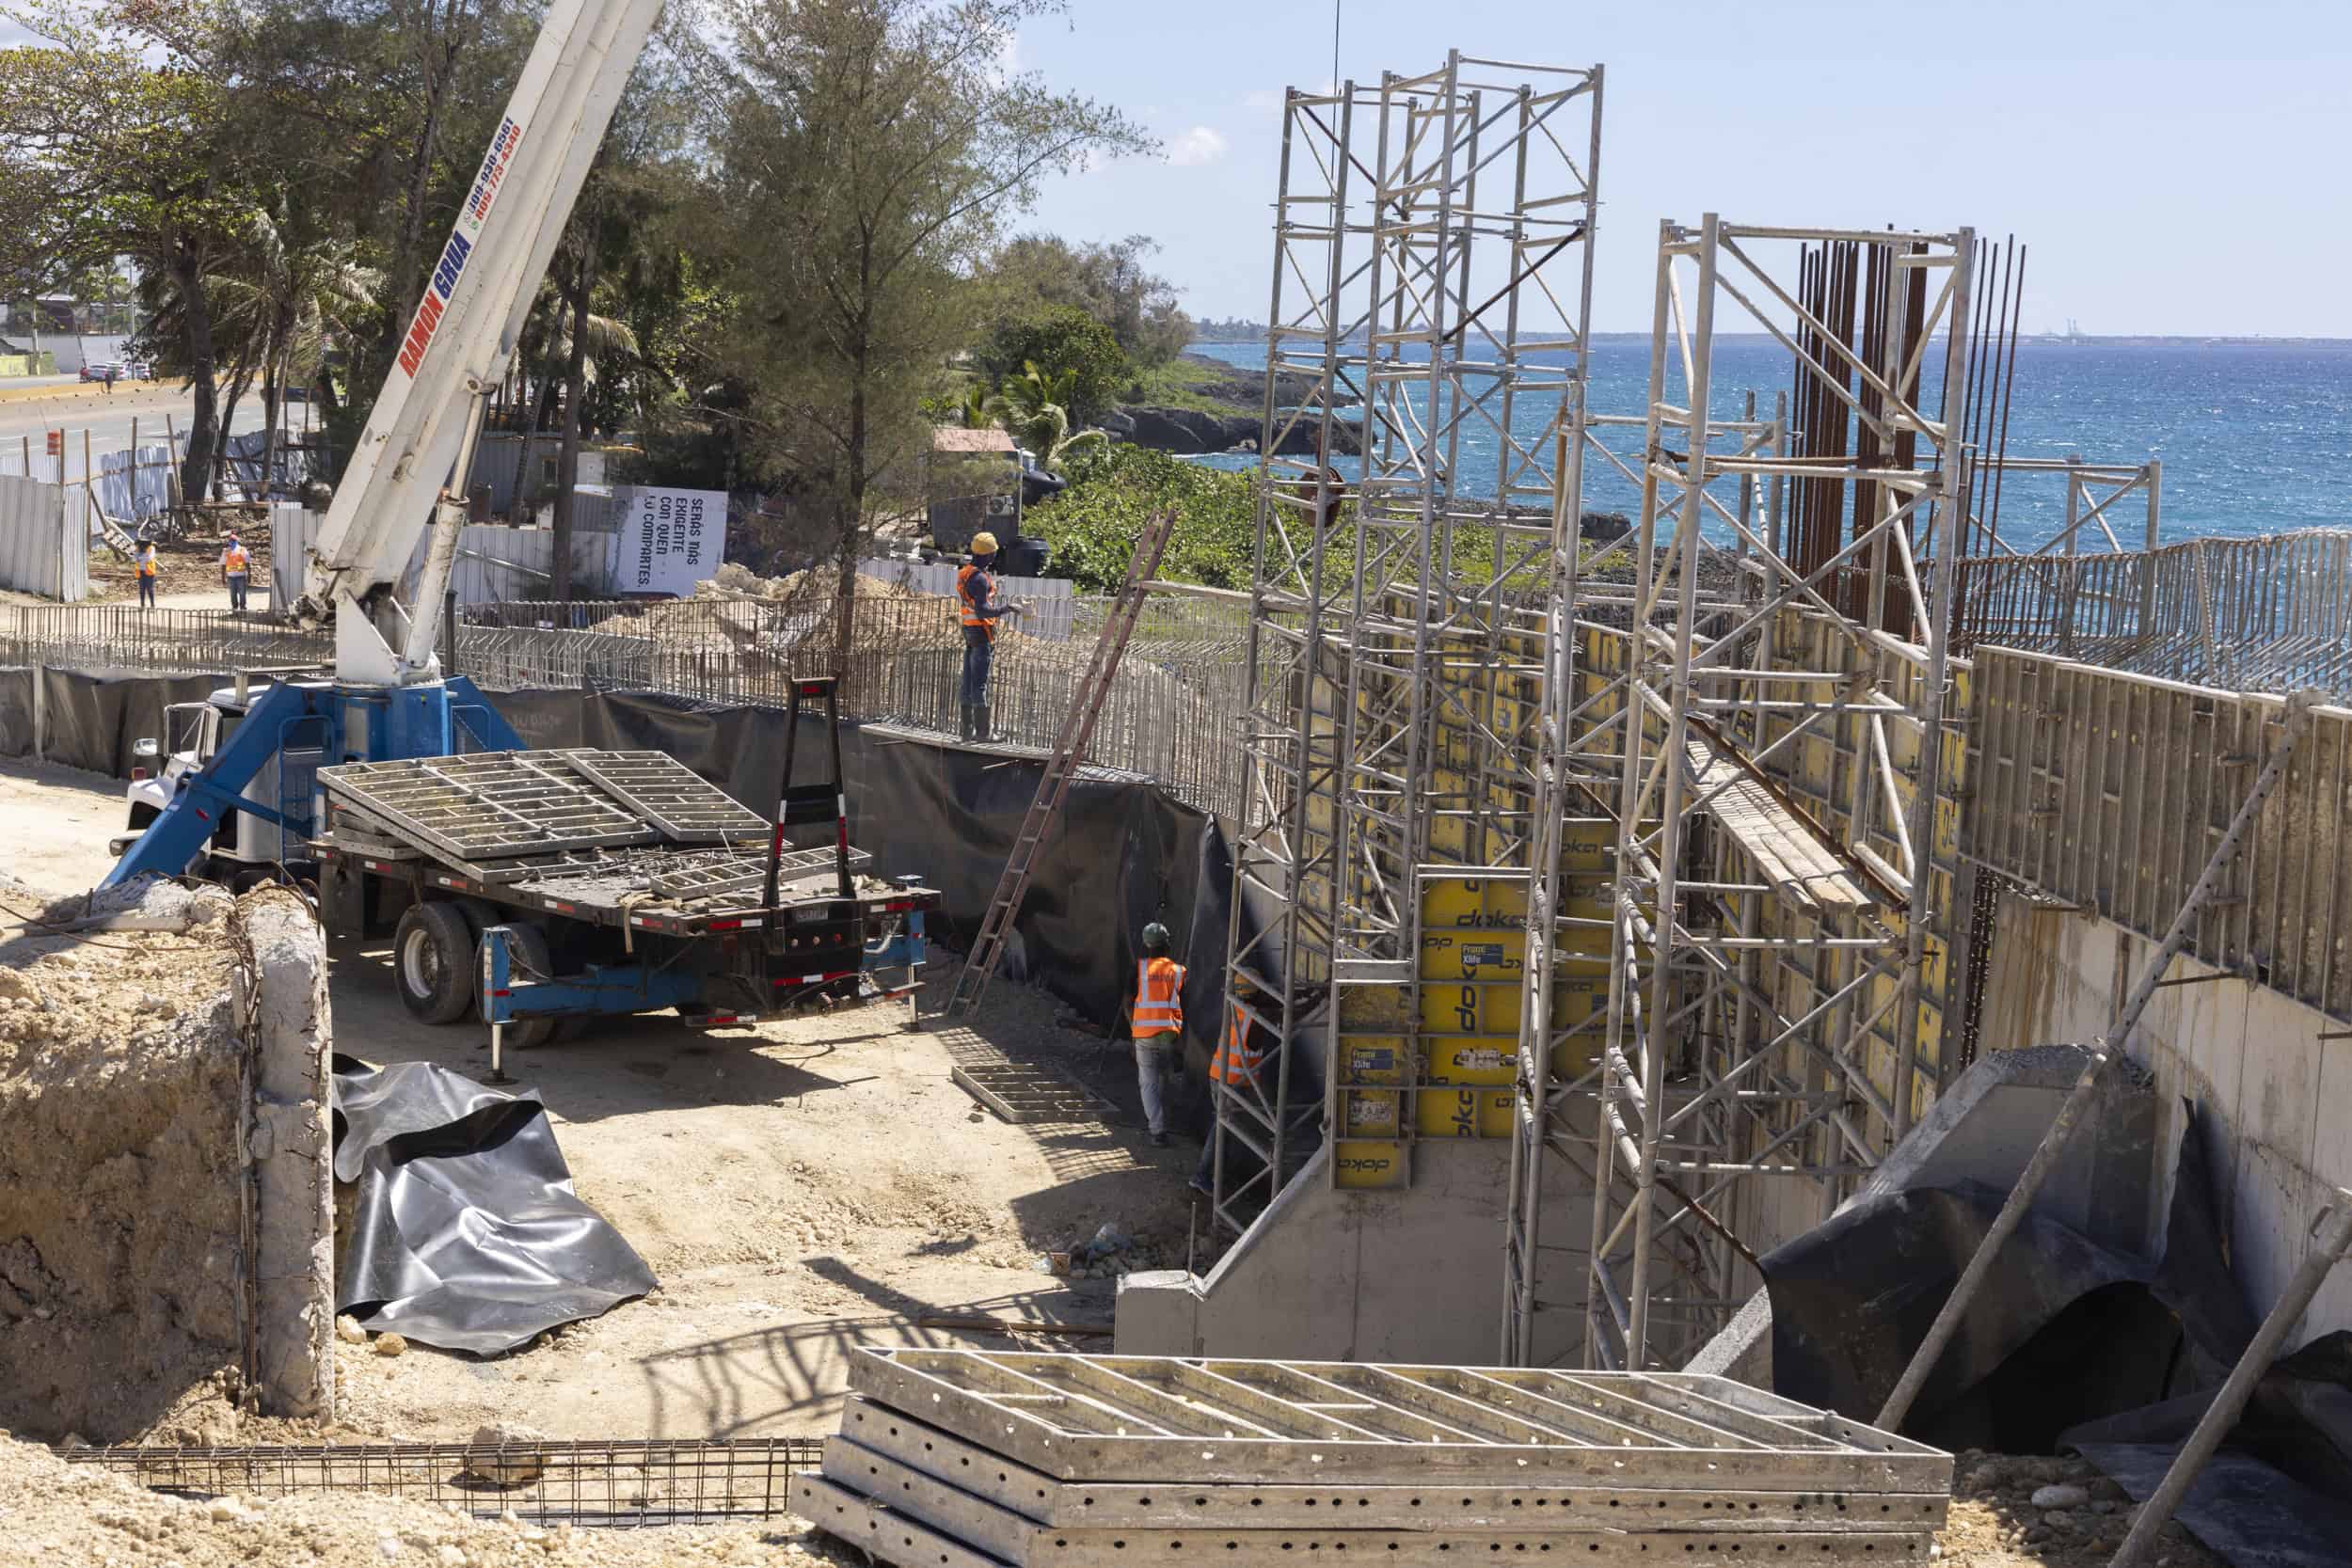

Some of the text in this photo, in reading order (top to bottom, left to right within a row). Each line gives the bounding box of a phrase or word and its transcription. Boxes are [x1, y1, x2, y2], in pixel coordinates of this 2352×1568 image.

[398, 230, 472, 379] RAMON GRUA
[659, 497, 672, 519] CON
[673, 498, 688, 553] EXIGENTE
